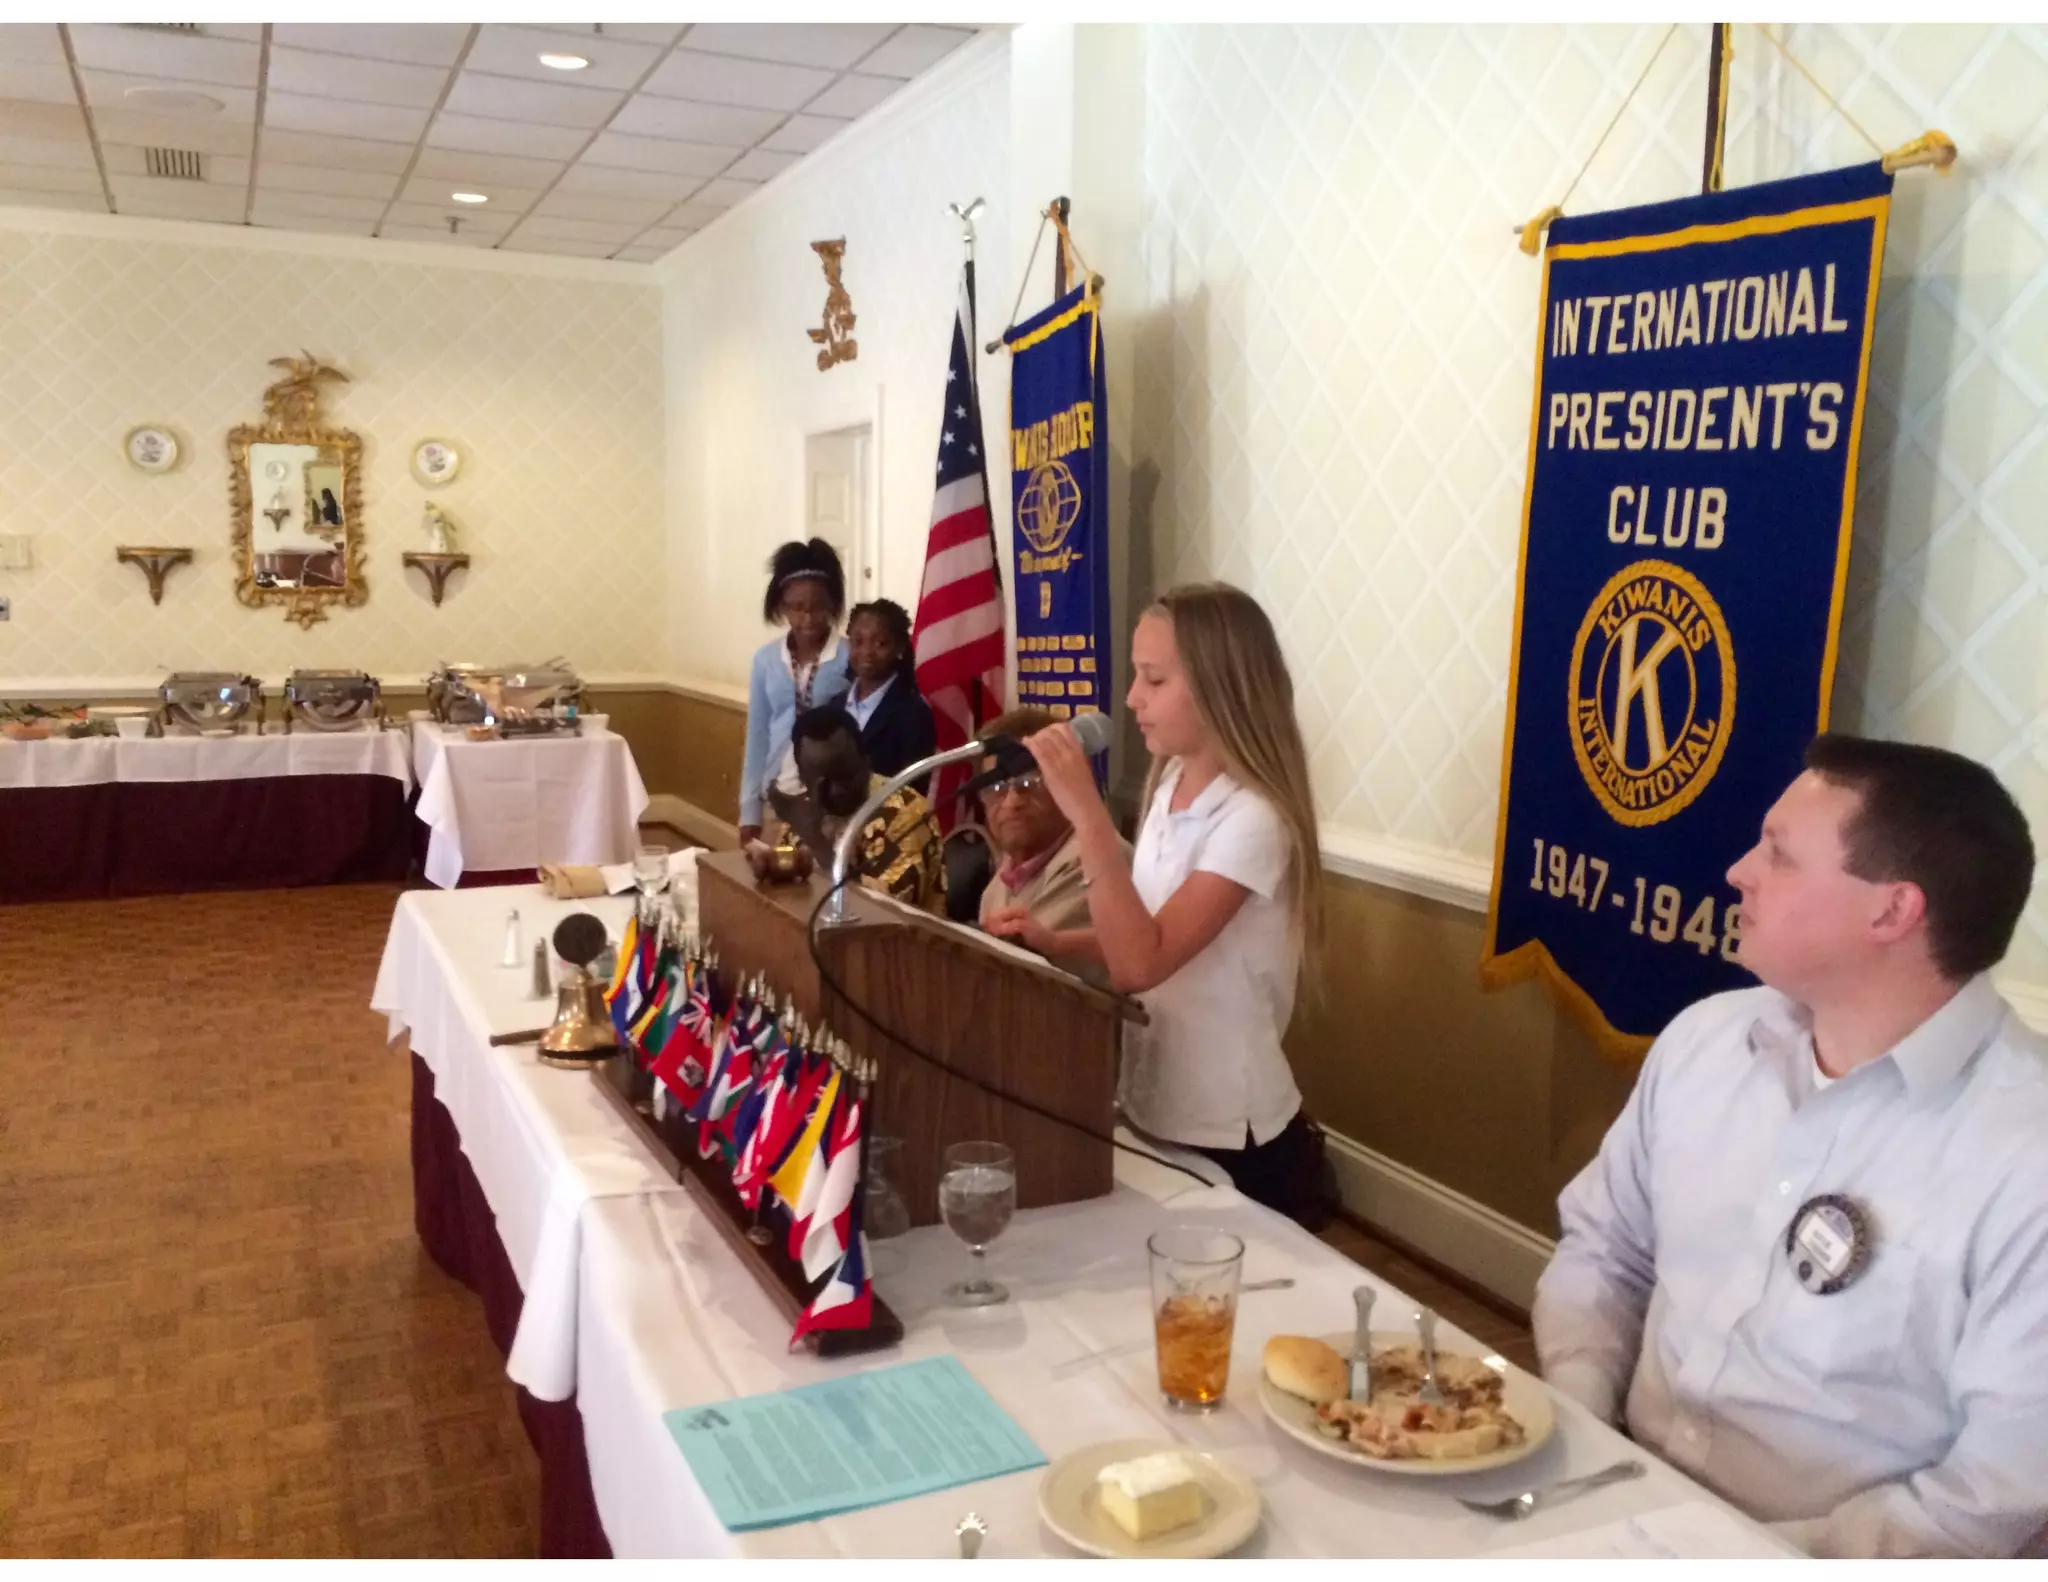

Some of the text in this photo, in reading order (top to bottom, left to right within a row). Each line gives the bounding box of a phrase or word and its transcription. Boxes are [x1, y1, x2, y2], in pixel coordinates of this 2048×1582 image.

[1552, 263, 1848, 358] INTERNATIONAL
[1548, 382, 1844, 451] PRESIDENT'S
[1607, 485, 1727, 549] CLUB
[1599, 579, 1712, 652] KIWANIS
[1612, 617, 1679, 773] K
[1579, 697, 1716, 808] INTERNATIONAL
